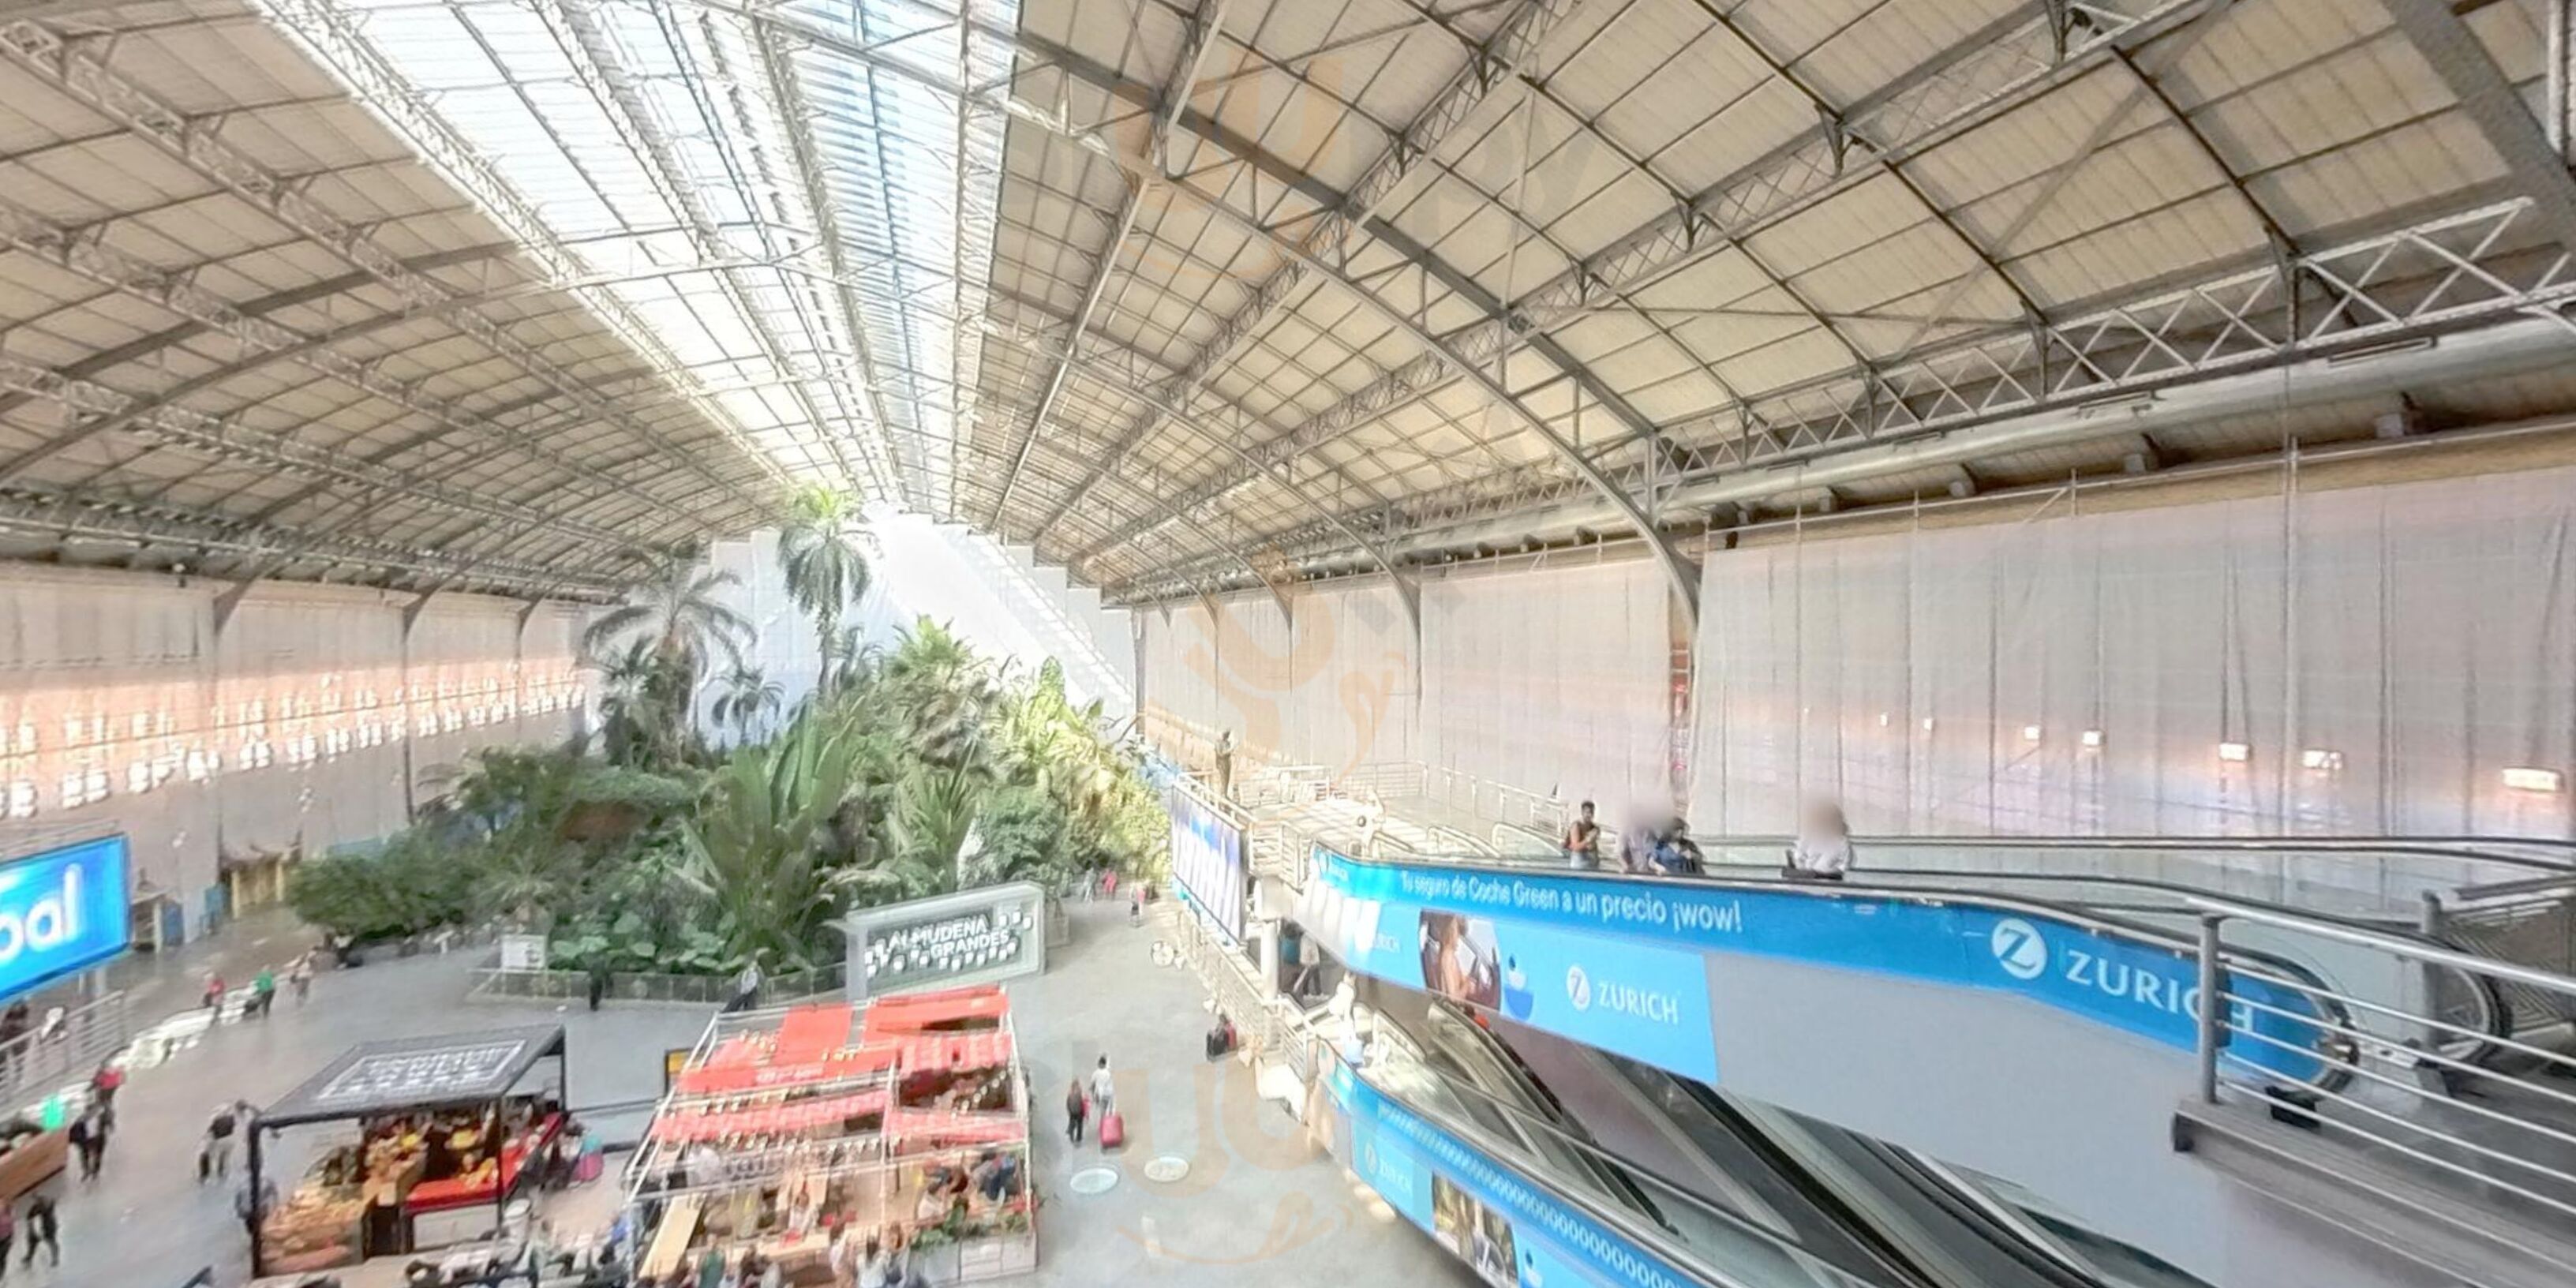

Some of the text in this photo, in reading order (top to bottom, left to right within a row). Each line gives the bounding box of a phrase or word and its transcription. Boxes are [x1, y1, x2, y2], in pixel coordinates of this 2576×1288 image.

[1401, 870, 1743, 934] Tu seguro de Coche Green a un precio ¡wow!
[889, 913, 990, 953] ALMUDENA
[930, 929, 1010, 960] GRANDES
[1597, 983, 1680, 1025] ZURICH
